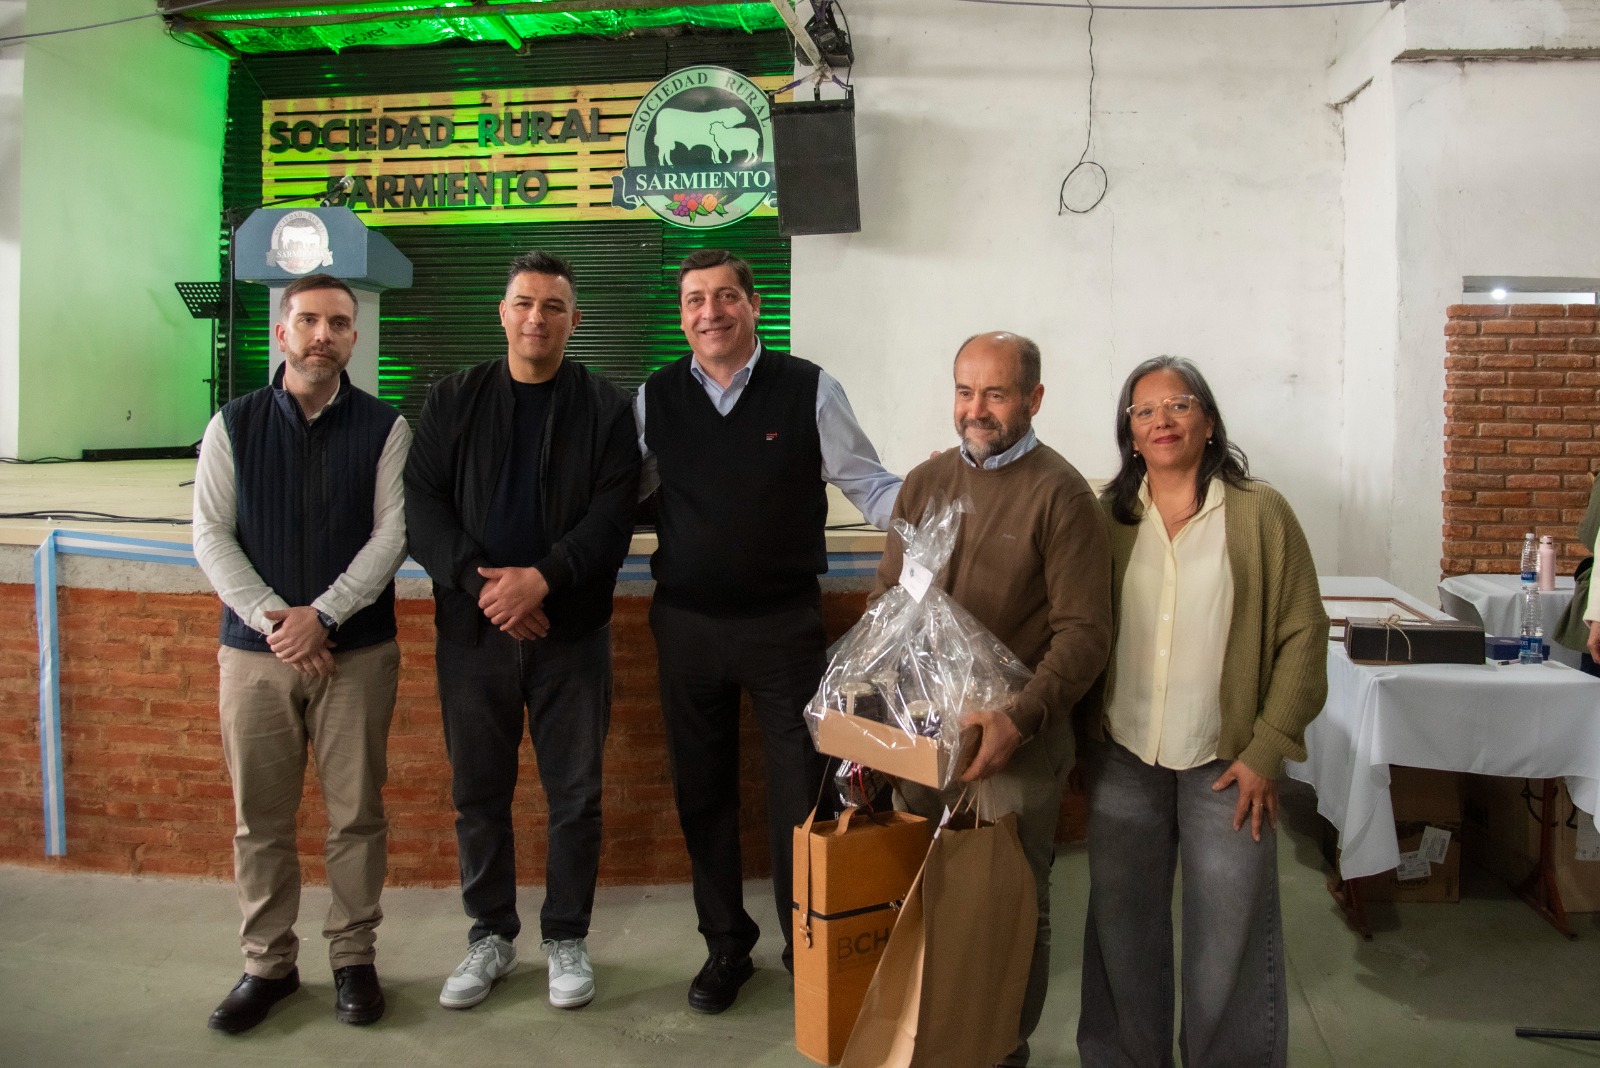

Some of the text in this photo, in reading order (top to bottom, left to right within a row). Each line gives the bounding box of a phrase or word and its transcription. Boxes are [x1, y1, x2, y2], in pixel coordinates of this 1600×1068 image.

[635, 72, 771, 132] SOCIEDAD RURAL
[269, 107, 611, 153] SOCIEDAD RURAL
[636, 170, 771, 191] SARMIENTO
